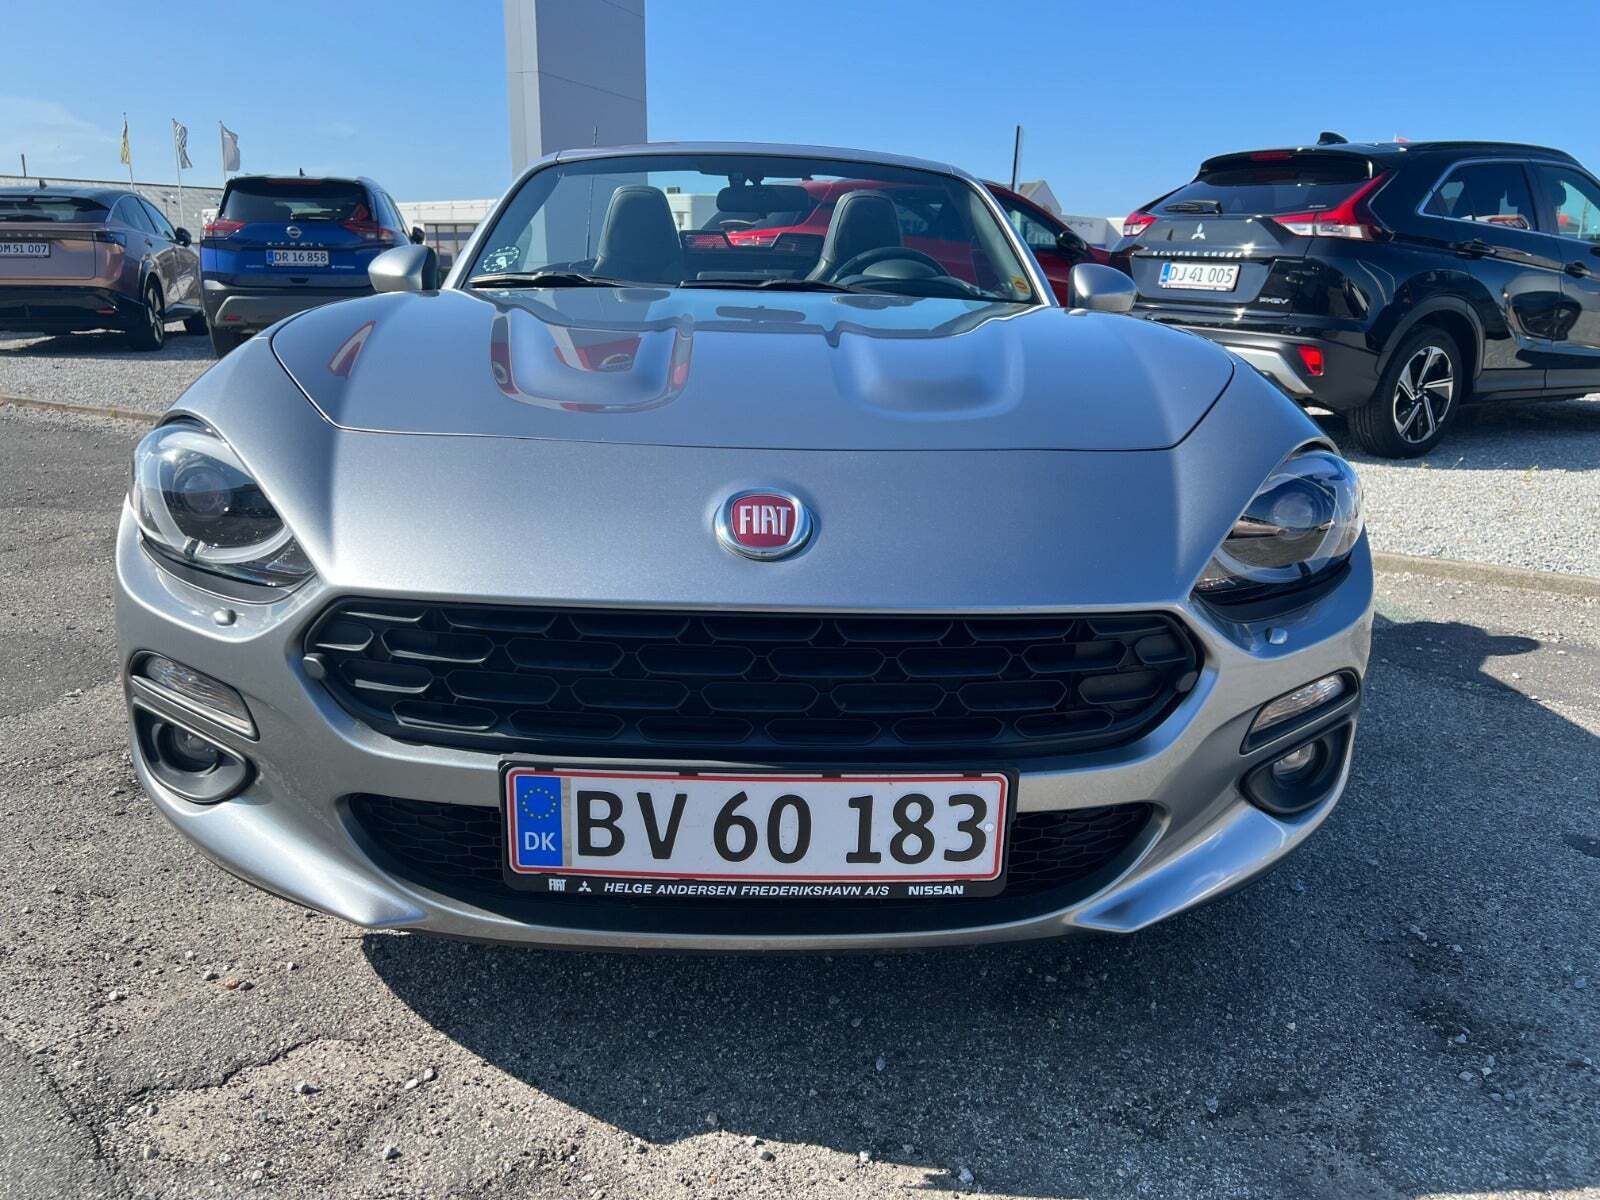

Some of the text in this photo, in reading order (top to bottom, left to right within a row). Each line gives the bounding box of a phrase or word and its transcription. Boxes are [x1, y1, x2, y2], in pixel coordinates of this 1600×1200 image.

[13, 244, 24, 253] 51
[28, 244, 47, 253] 007
[274, 252, 327, 262] DR 16 858
[1169, 266, 1187, 281] DJ
[1189, 267, 1203, 282] 41
[1208, 268, 1234, 283] 005
[739, 505, 792, 537] FIAT
[577, 790, 988, 865] BV 60 183
[524, 831, 556, 851] DK
[549, 878, 567, 891] FIAT
[604, 882, 890, 896] HELGE ANDERSEN FREDERIKSHAVN A/S
[908, 885, 964, 895] NISSAN
